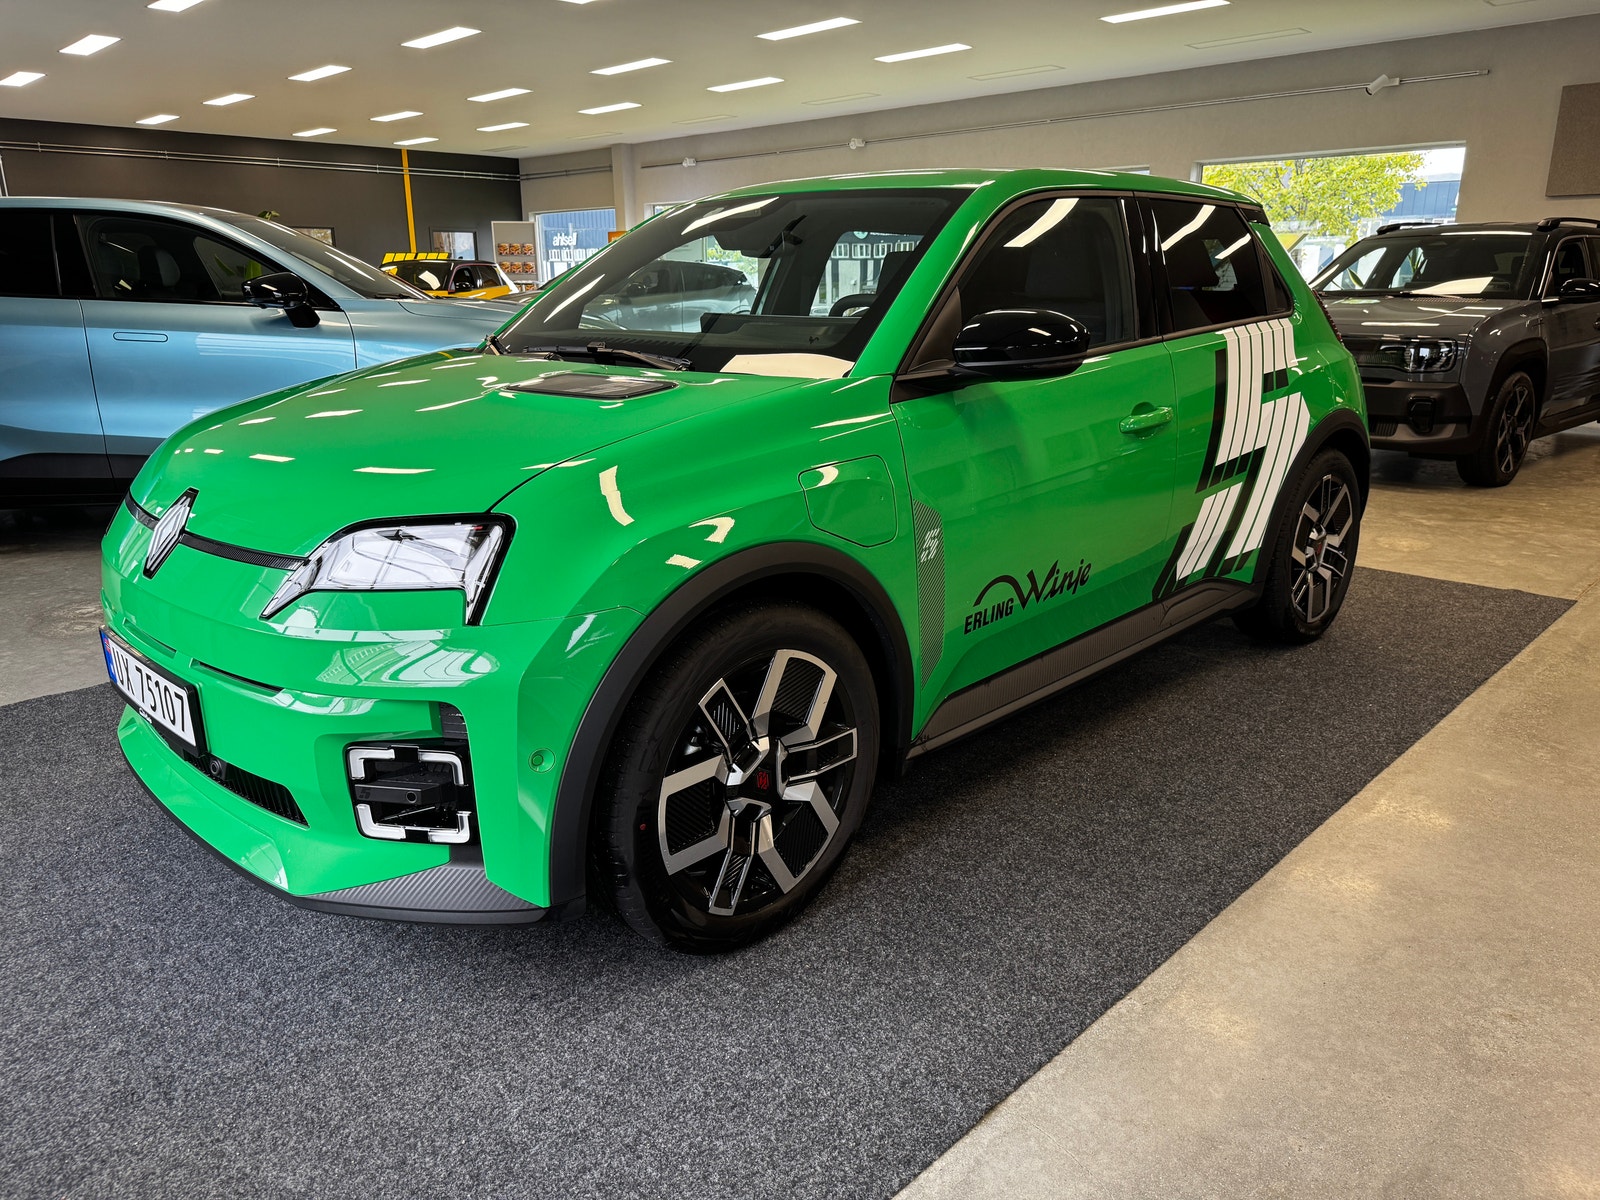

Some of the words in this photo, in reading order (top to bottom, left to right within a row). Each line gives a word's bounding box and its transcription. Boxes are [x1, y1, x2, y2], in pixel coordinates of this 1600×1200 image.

[552, 232, 577, 246] ahlsell
[973, 558, 1092, 611] Winje
[963, 597, 1015, 635] ERLING
[112, 646, 135, 697] UX
[135, 664, 186, 733] 75107
